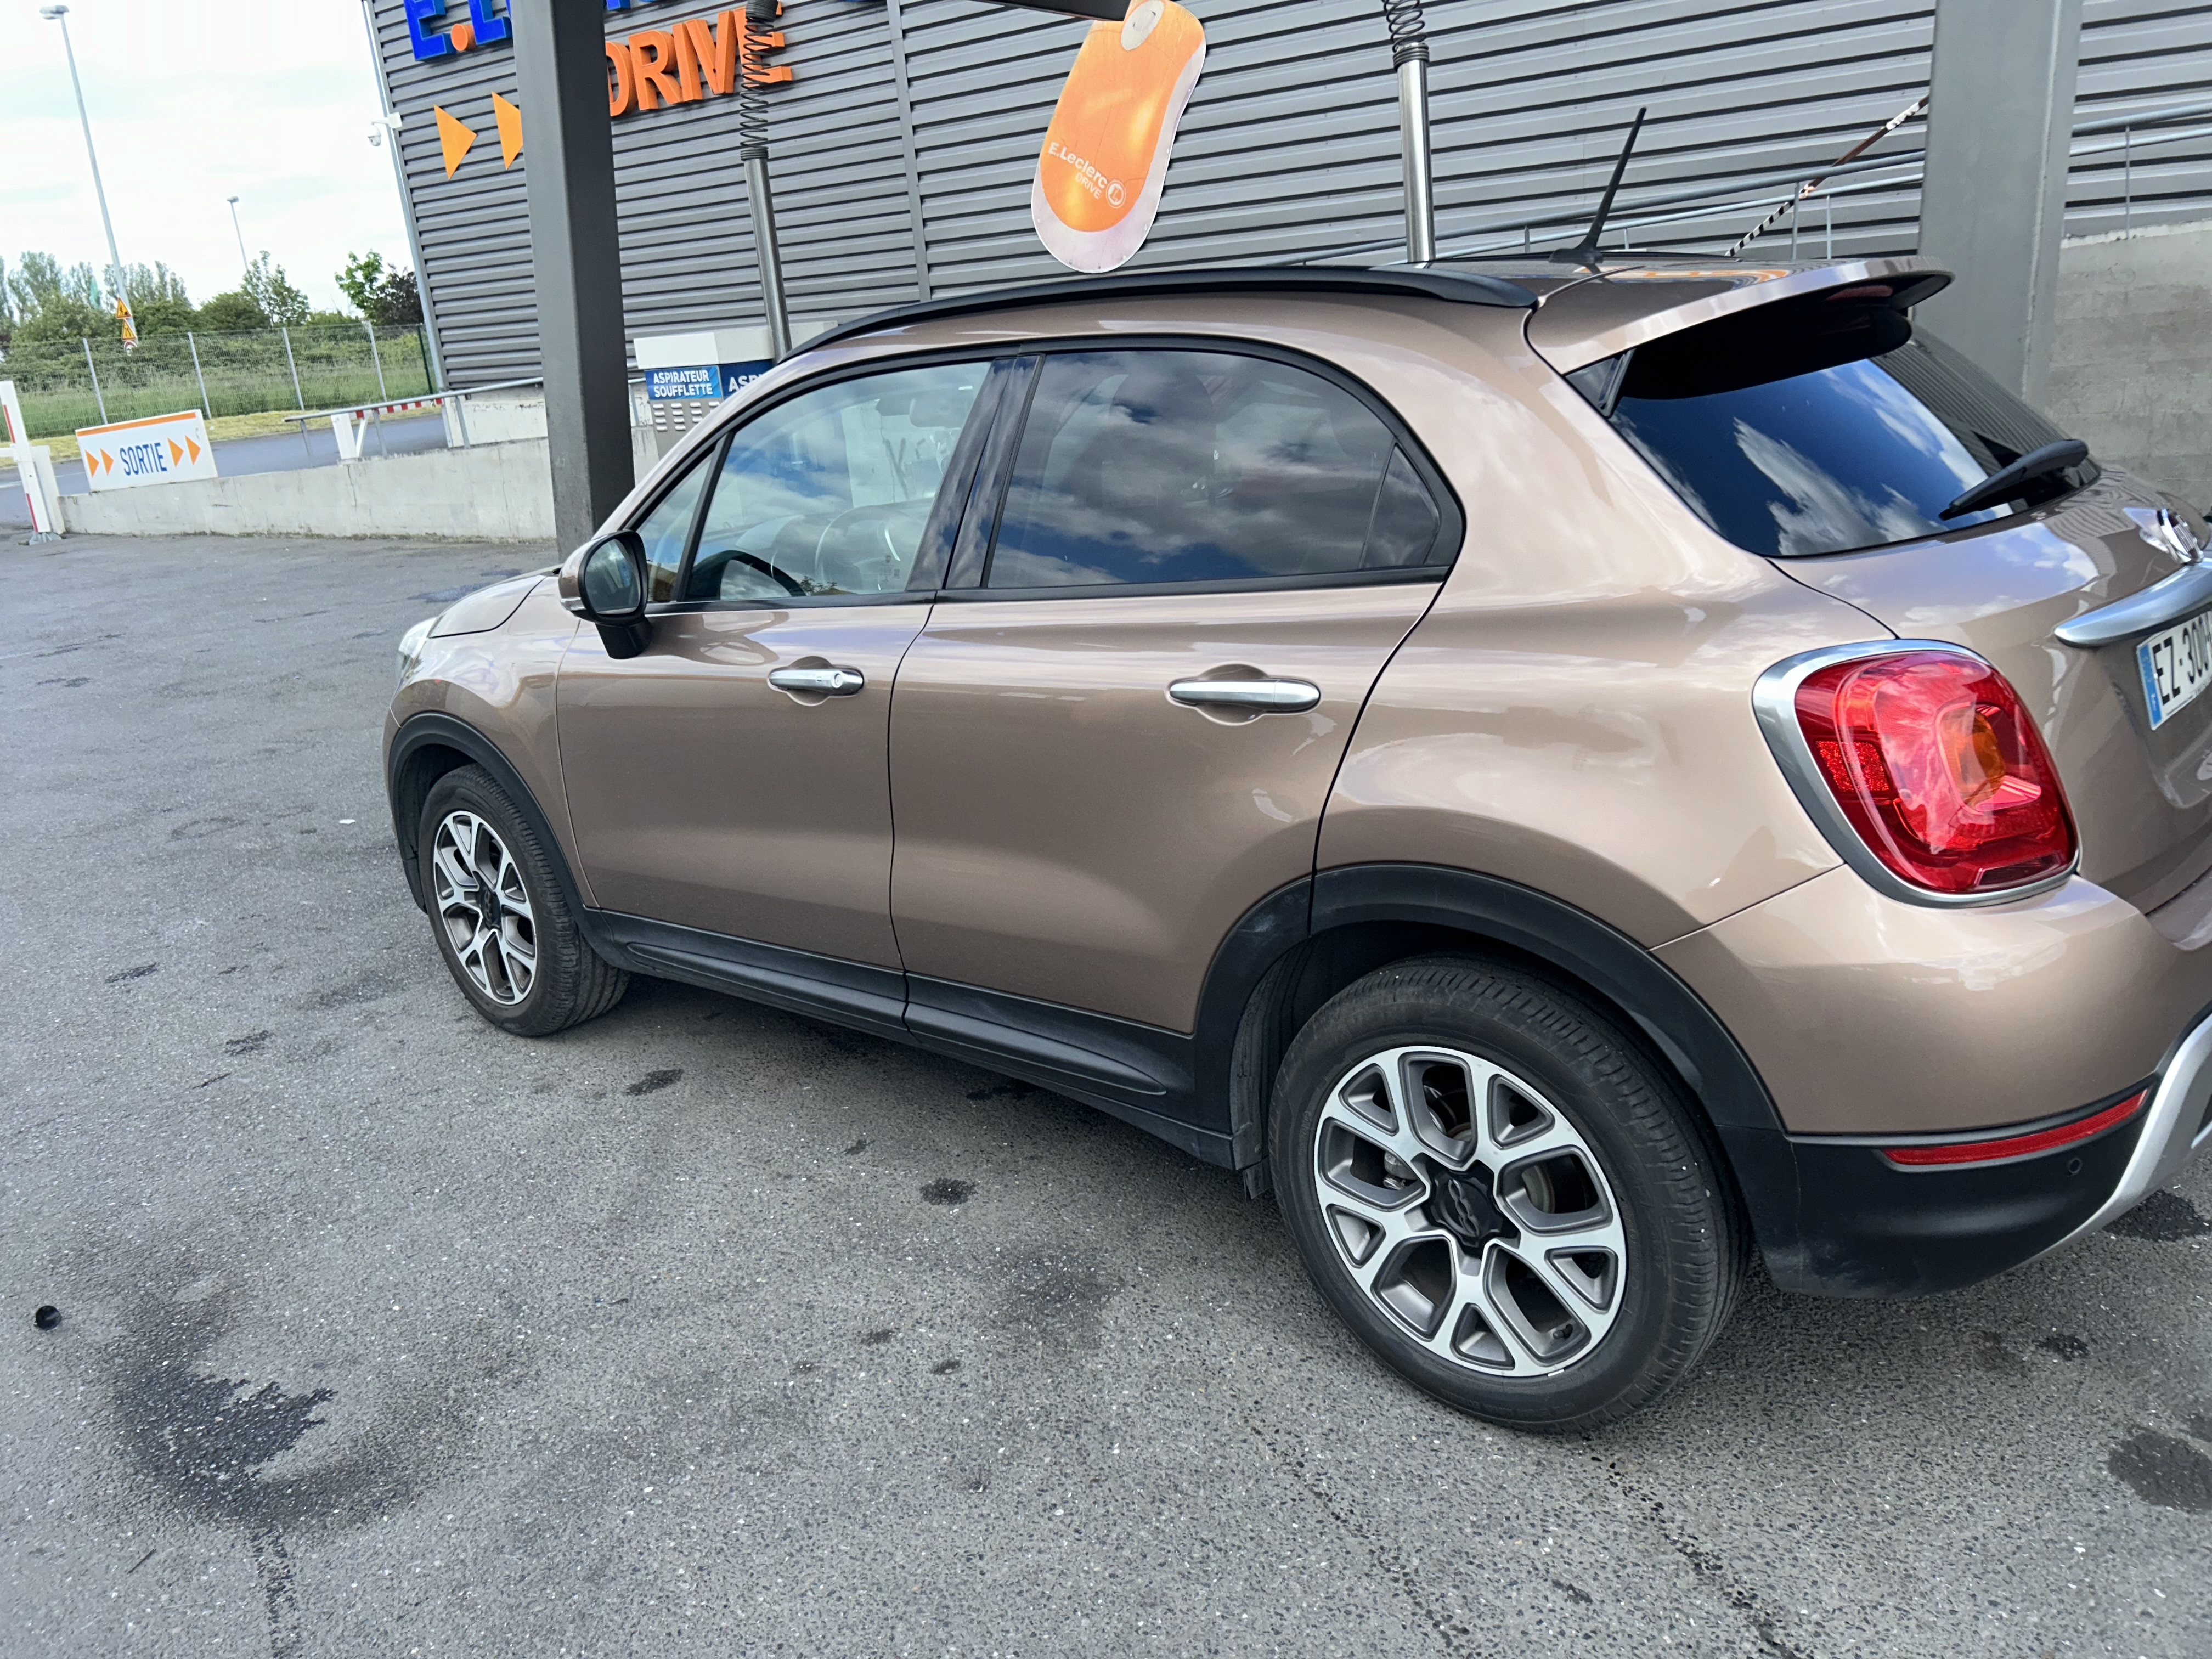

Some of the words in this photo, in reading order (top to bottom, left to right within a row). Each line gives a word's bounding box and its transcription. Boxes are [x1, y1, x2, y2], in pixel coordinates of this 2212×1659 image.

[1048, 141, 1108, 189] E.Leclerc
[1075, 172, 1102, 199] DRIVE
[653, 370, 710, 384] ASPIRATEUR
[729, 374, 763, 392] ASP
[653, 383, 713, 398] SOUFFLETTE
[119, 442, 167, 476] SORTIE
